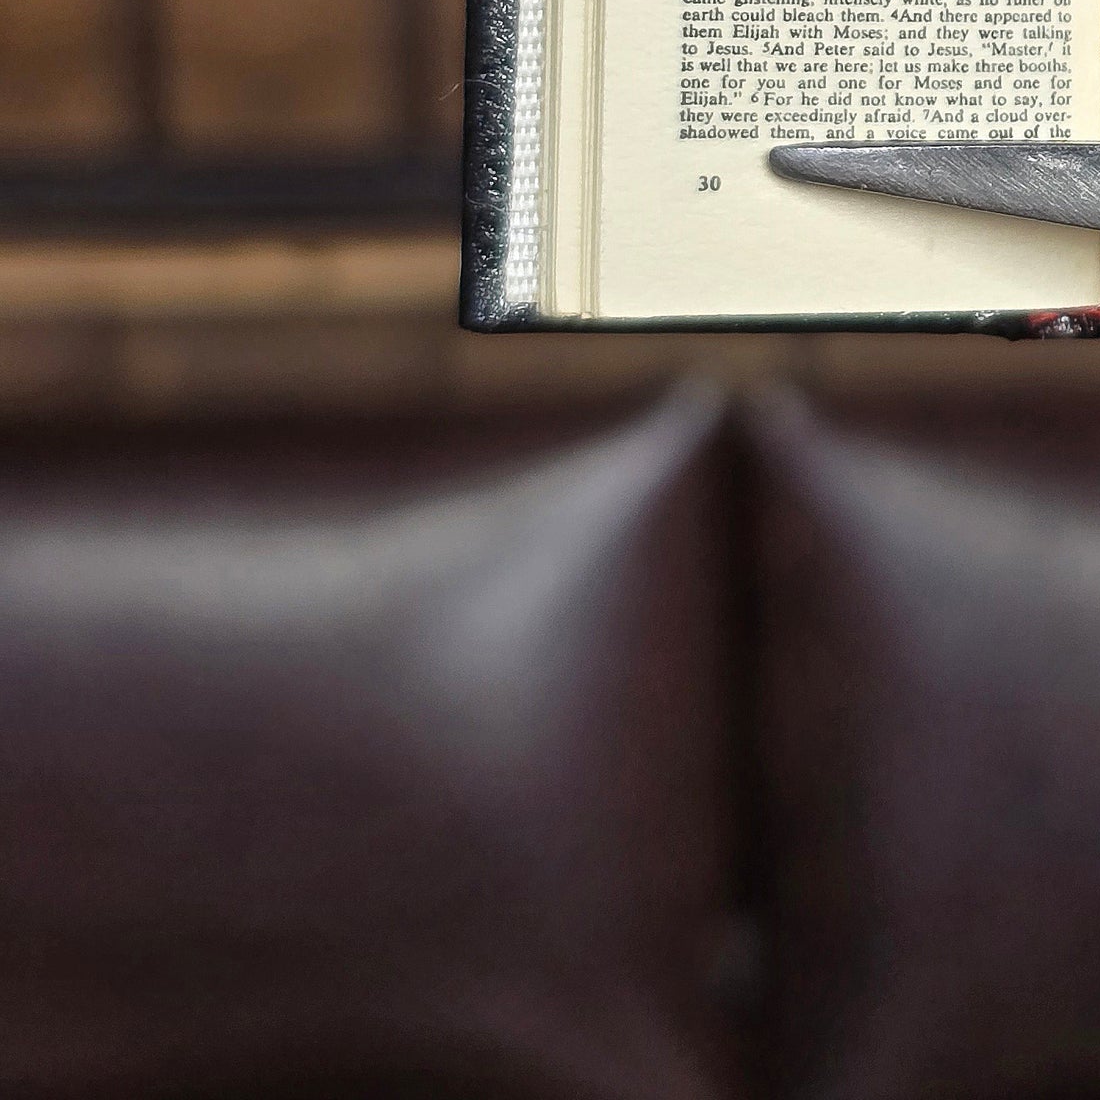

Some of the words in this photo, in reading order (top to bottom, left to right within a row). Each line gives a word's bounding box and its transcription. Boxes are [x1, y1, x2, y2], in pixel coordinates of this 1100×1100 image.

[681, 24, 723, 38] them
[732, 24, 780, 42] Elijah
[788, 24, 823, 39] with
[833, 25, 888, 41] Moses;
[898, 25, 927, 39] and
[936, 25, 969, 43] they
[978, 29, 1014, 39] were
[1022, 25, 1072, 43] talking
[679, 125, 759, 139] shadowed
[770, 125, 814, 141] them,
[825, 124, 855, 138] and
[866, 128, 875, 138] a
[886, 124, 926, 138] voice
[937, 128, 978, 138] came
[988, 126, 1013, 138] out
[1023, 124, 1040, 138] of
[1049, 124, 1071, 138] the
[698, 175, 721, 191] 30
